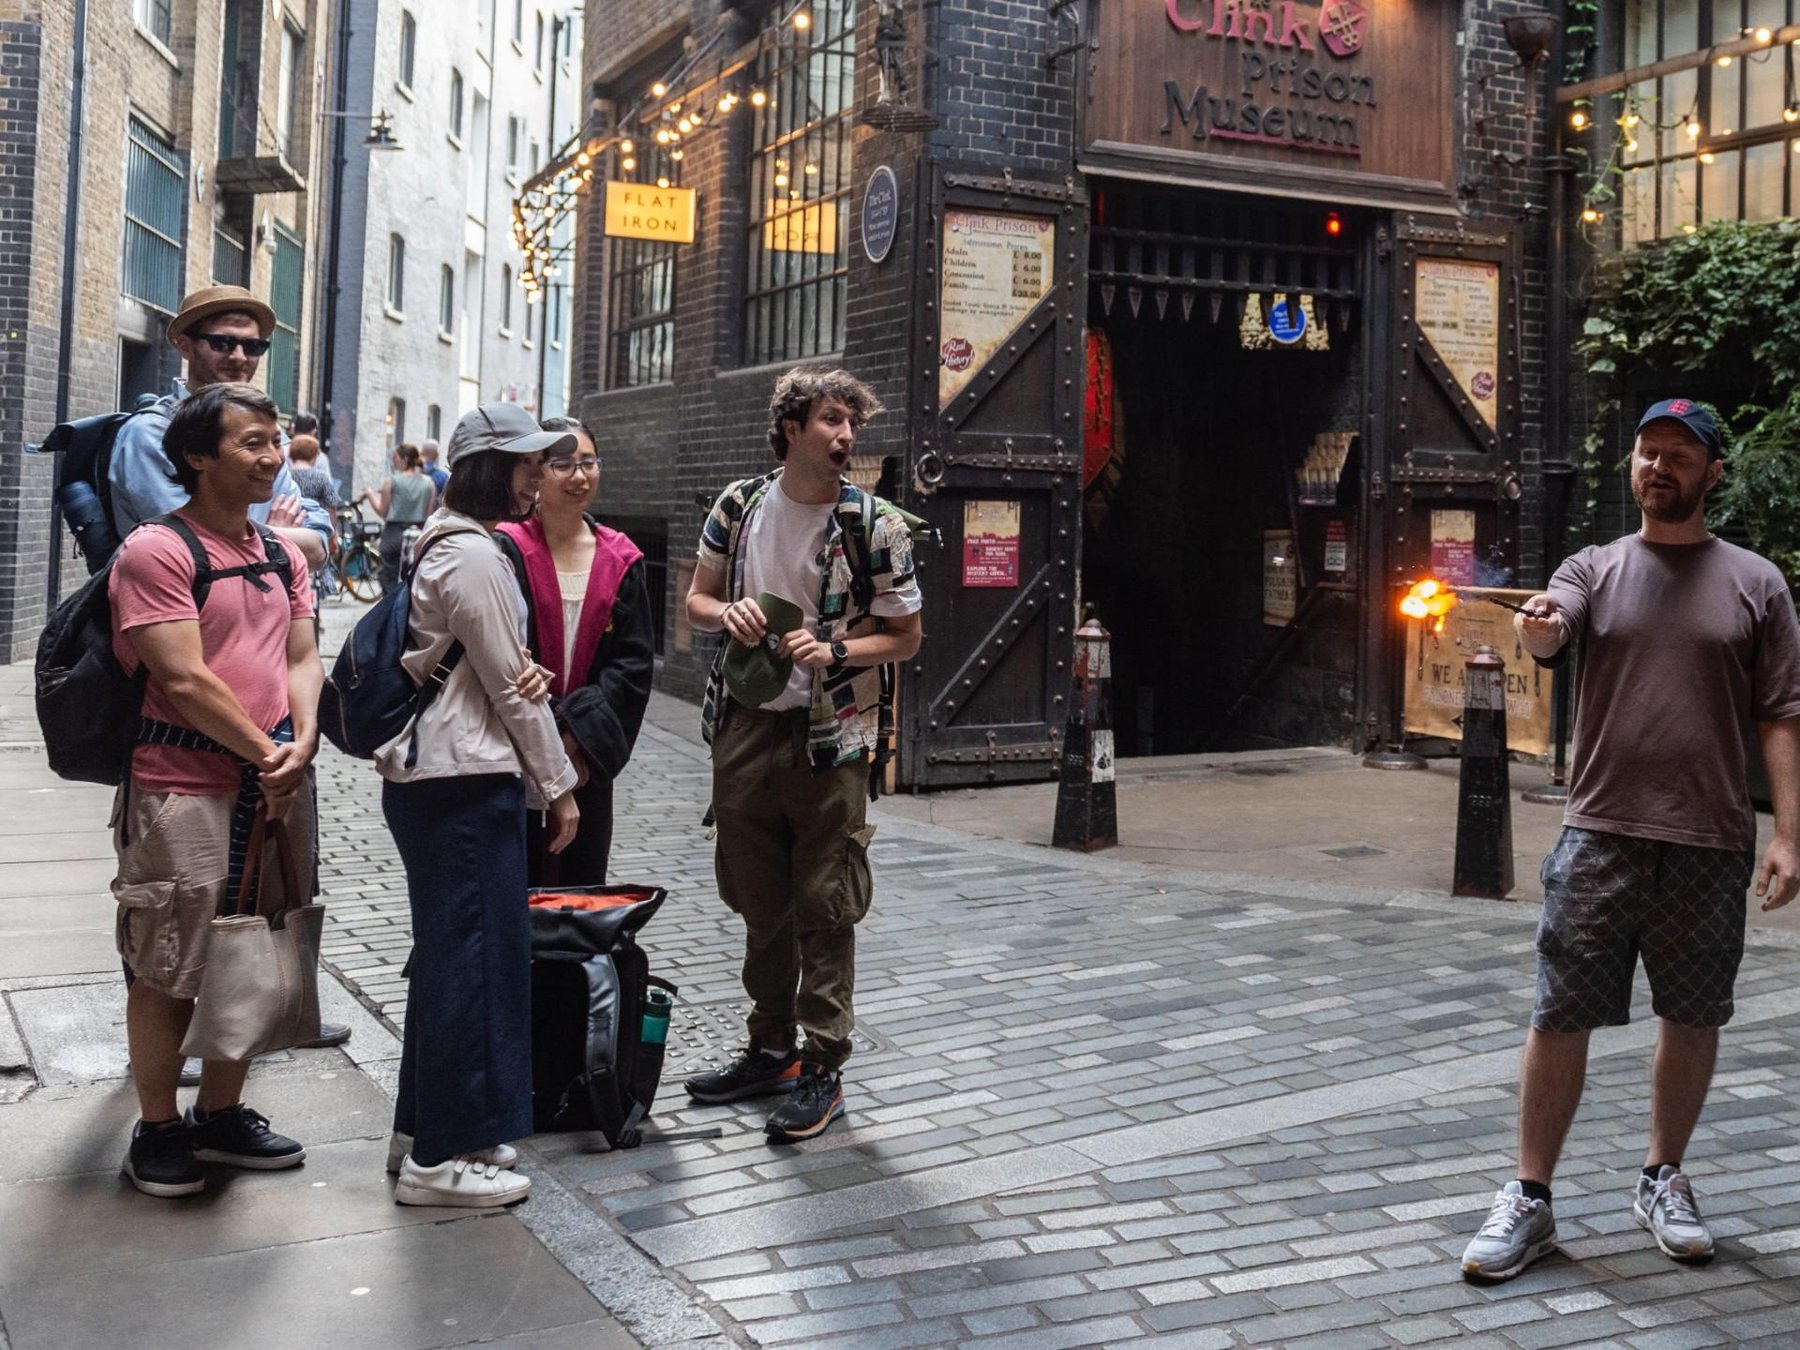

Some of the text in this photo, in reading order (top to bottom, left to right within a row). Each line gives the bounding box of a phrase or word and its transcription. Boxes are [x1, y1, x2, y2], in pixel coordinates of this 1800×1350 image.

[1166, 0, 1316, 51] Clink
[1160, 80, 1360, 148] Museum
[624, 192, 677, 208] FLAT
[623, 215, 677, 231] IRON
[995, 218, 1036, 234] Prison
[944, 258, 977, 268] Children
[944, 282, 968, 291] Family
[948, 338, 967, 352] Real
[1432, 664, 1451, 684] WE
